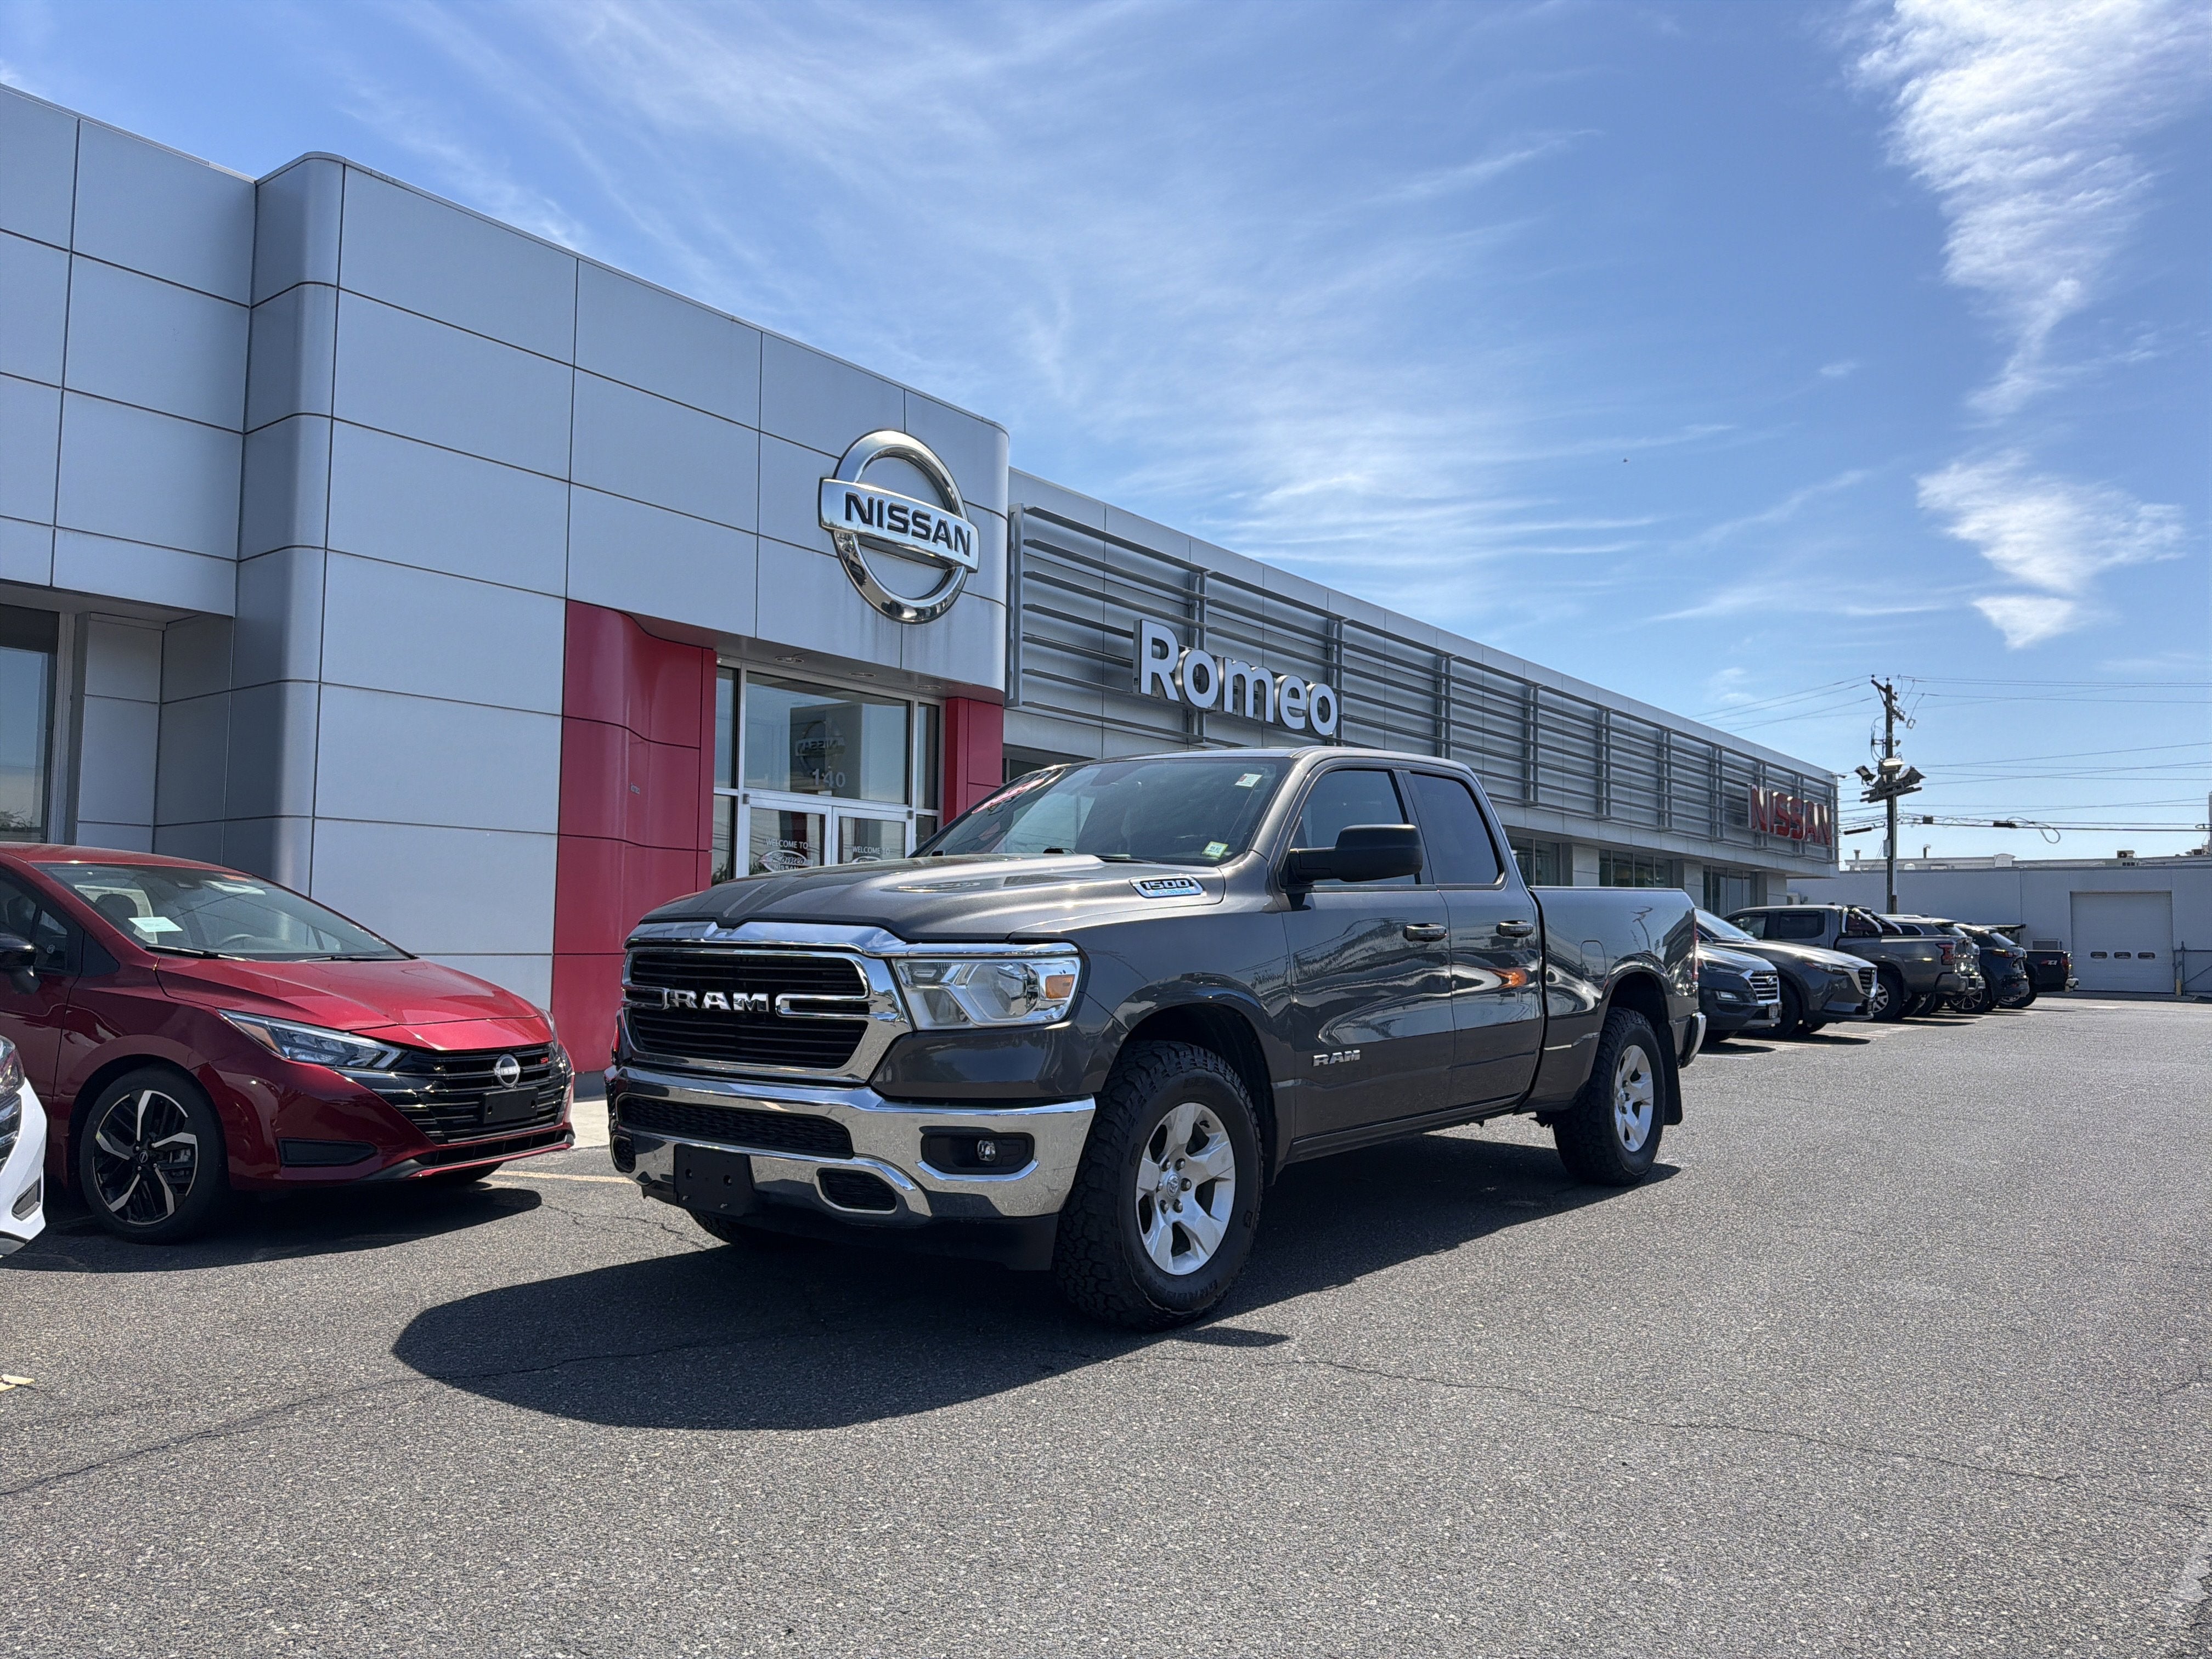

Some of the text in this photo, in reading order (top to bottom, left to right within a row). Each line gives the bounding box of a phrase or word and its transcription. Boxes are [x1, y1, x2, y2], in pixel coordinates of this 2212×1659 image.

[845, 491, 970, 558] NISSAN
[1135, 619, 1338, 736] Romeo
[812, 768, 846, 788] 140
[1747, 783, 1833, 847] NISSAN
[766, 838, 809, 850] WELCOME TO
[851, 845, 881, 855] WELCOME
[771, 851, 805, 865] Romeo
[1141, 879, 1190, 890] 1500
[669, 989, 770, 1012] RAM
[1313, 1049, 1361, 1067] RAM
